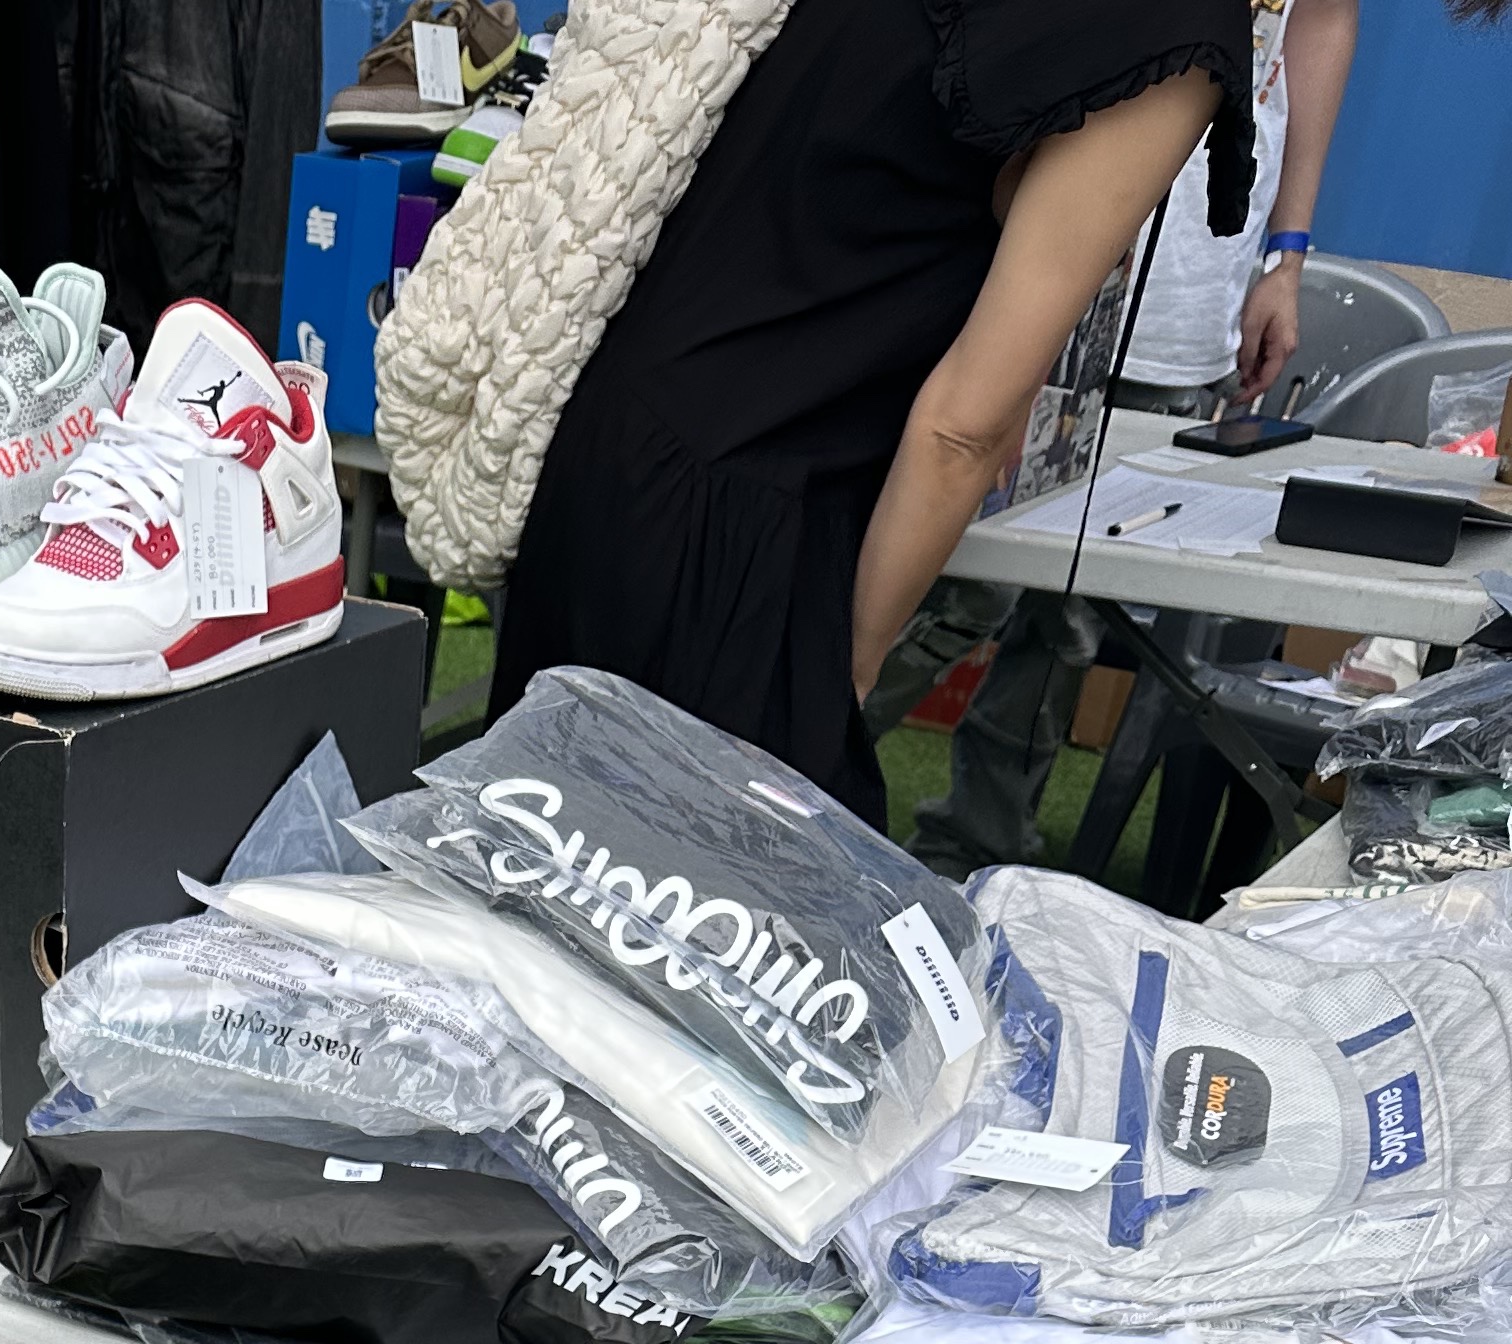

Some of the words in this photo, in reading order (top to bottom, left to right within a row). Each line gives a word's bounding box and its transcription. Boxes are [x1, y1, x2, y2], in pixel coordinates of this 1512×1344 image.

[212, 1003, 296, 1048] Recycle
[1200, 1073, 1230, 1141] CORDURA
[1369, 1086, 1417, 1172] Supreme
[530, 1243, 691, 1338] KREA
